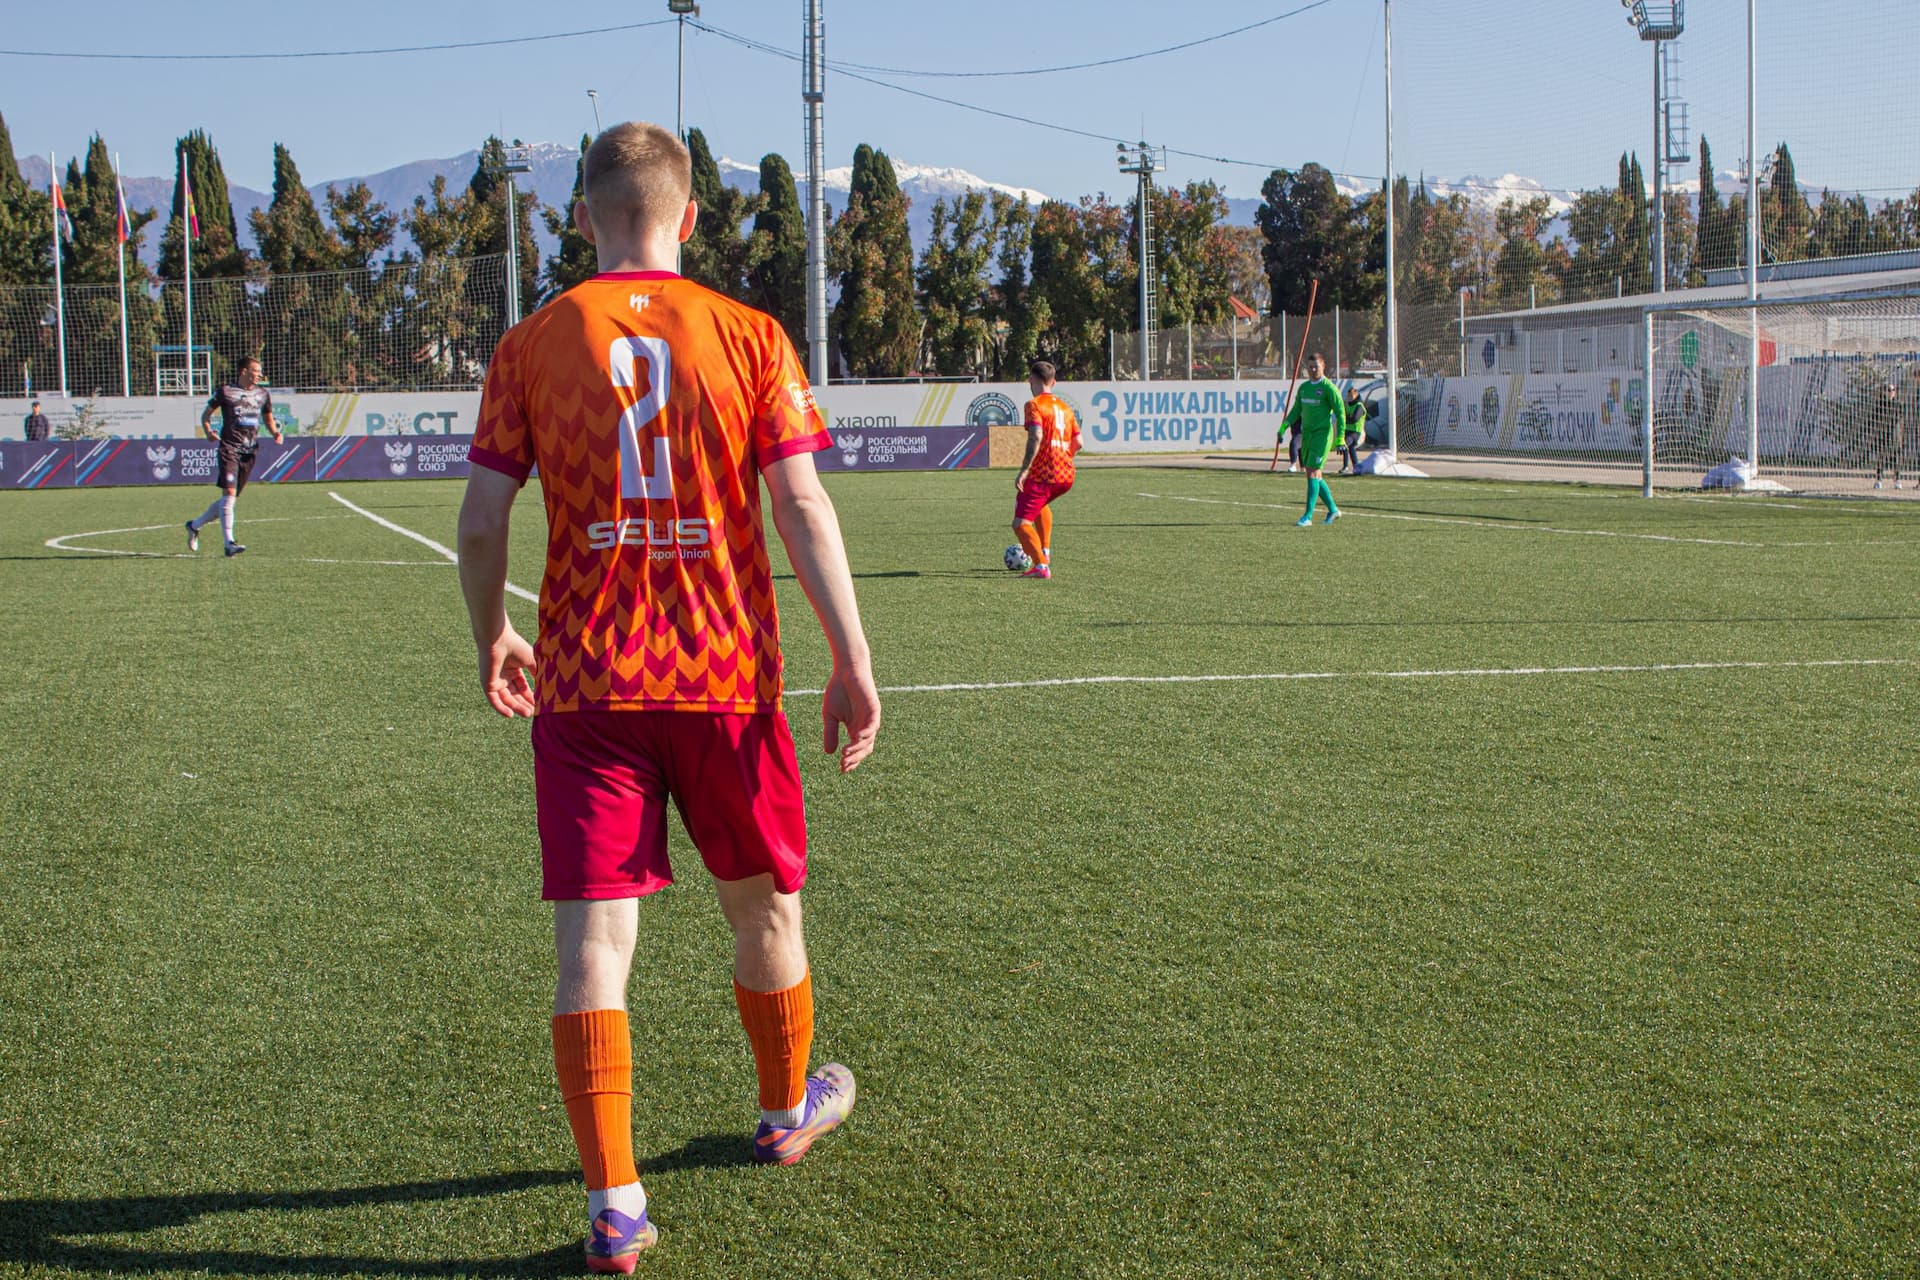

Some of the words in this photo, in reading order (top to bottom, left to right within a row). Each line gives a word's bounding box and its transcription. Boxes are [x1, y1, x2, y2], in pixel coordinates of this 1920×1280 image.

[1123, 391, 1288, 415] УНИКАЛЬНЫХ
[610, 336, 673, 499] 2
[1091, 390, 1118, 442] 3
[1053, 404, 1067, 440] 4
[1123, 417, 1232, 444] РЕКОРДА
[868, 435, 927, 446] РОССИЙСКИЙ
[417, 443, 471, 454] РОССИЙСК
[868, 445, 928, 454] ФУТБОЛЬНЫЙ
[181, 457, 219, 467] ФУТБОЛ
[417, 453, 468, 463] ФУТБОЛЬН
[868, 454, 895, 463] СОЮЗ
[181, 466, 211, 476] СОЮЗ
[418, 462, 447, 472] СОЮЗ
[680, 548, 711, 560] Union
